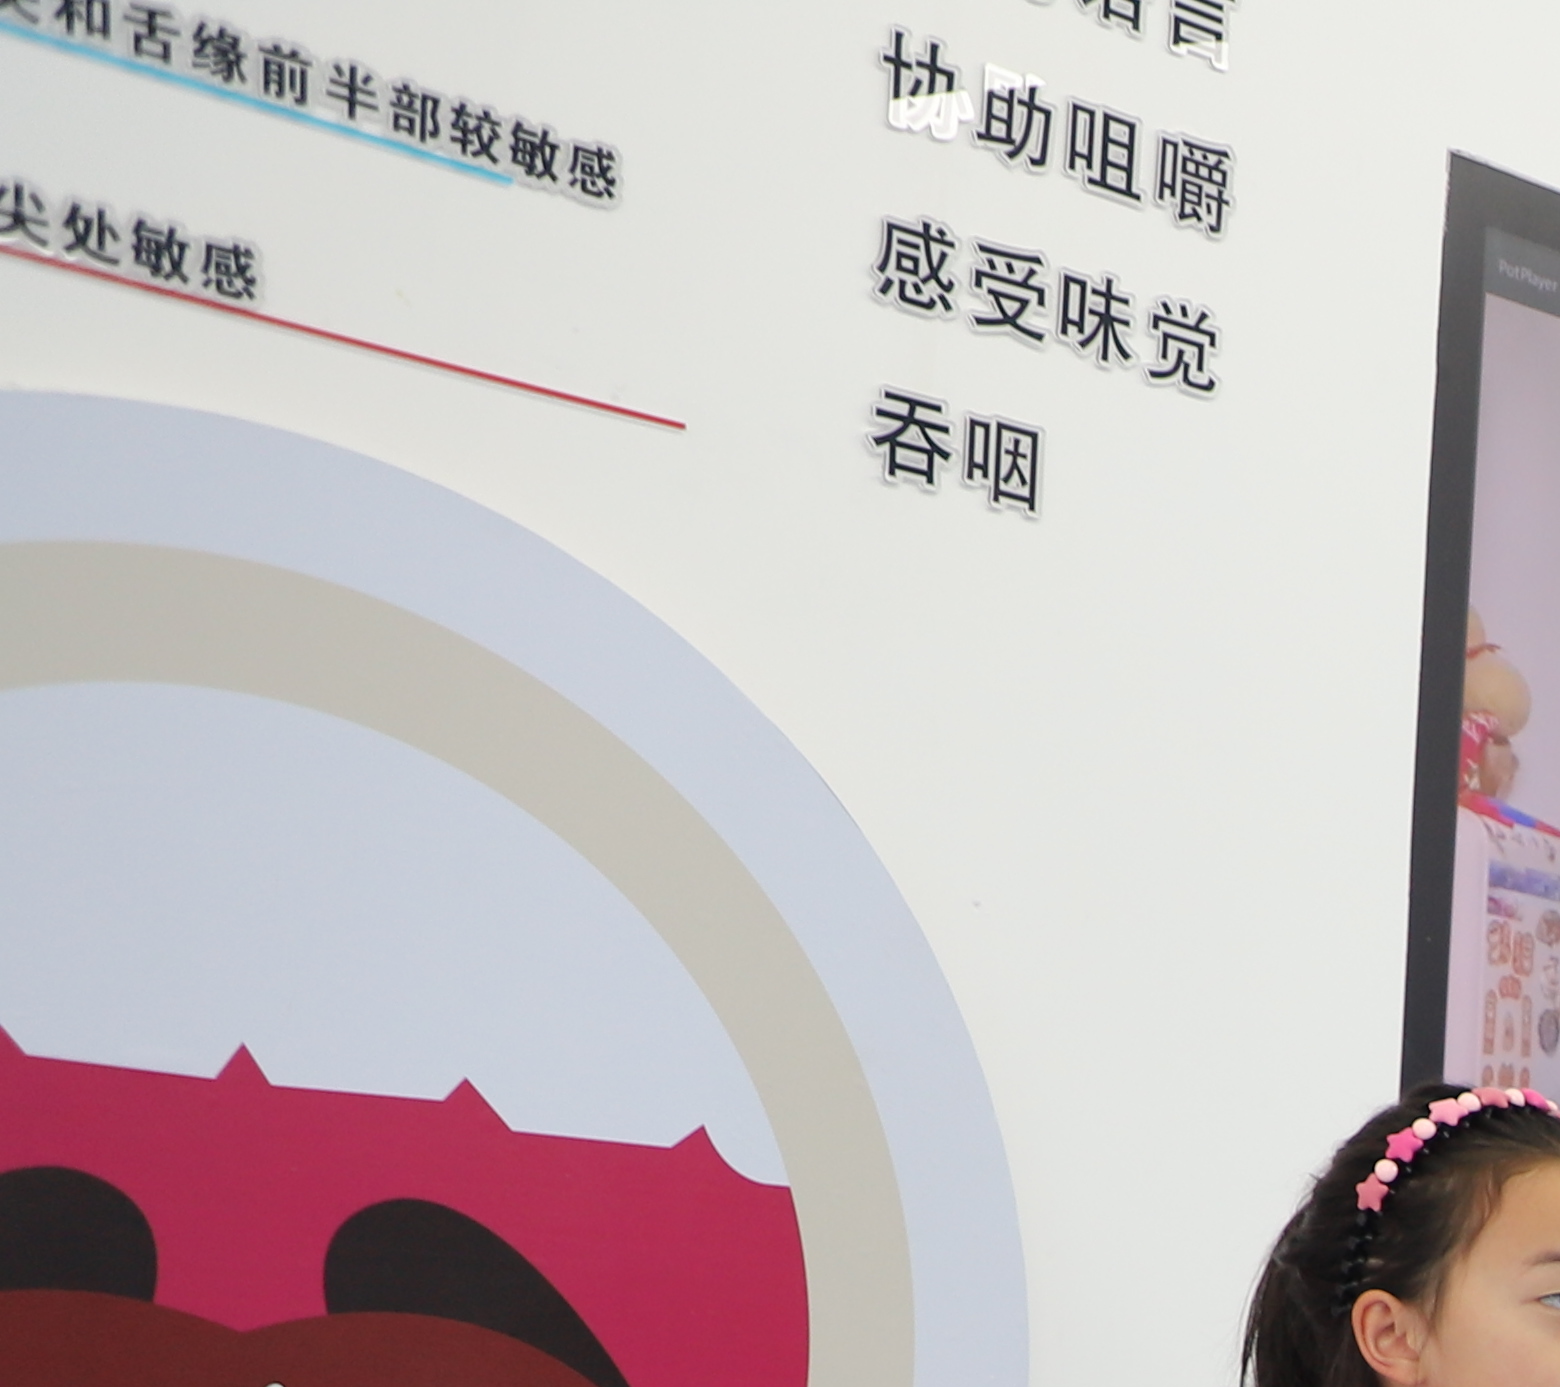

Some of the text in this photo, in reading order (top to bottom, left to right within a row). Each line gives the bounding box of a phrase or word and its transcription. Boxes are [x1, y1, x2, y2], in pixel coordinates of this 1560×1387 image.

[0, 0, 617, 200] 和舌缘前半部较敏感
[882, 30, 1232, 233] 协助咀嚼
[876, 217, 1219, 394] 感受味觉
[867, 391, 1043, 515] 吞咽
